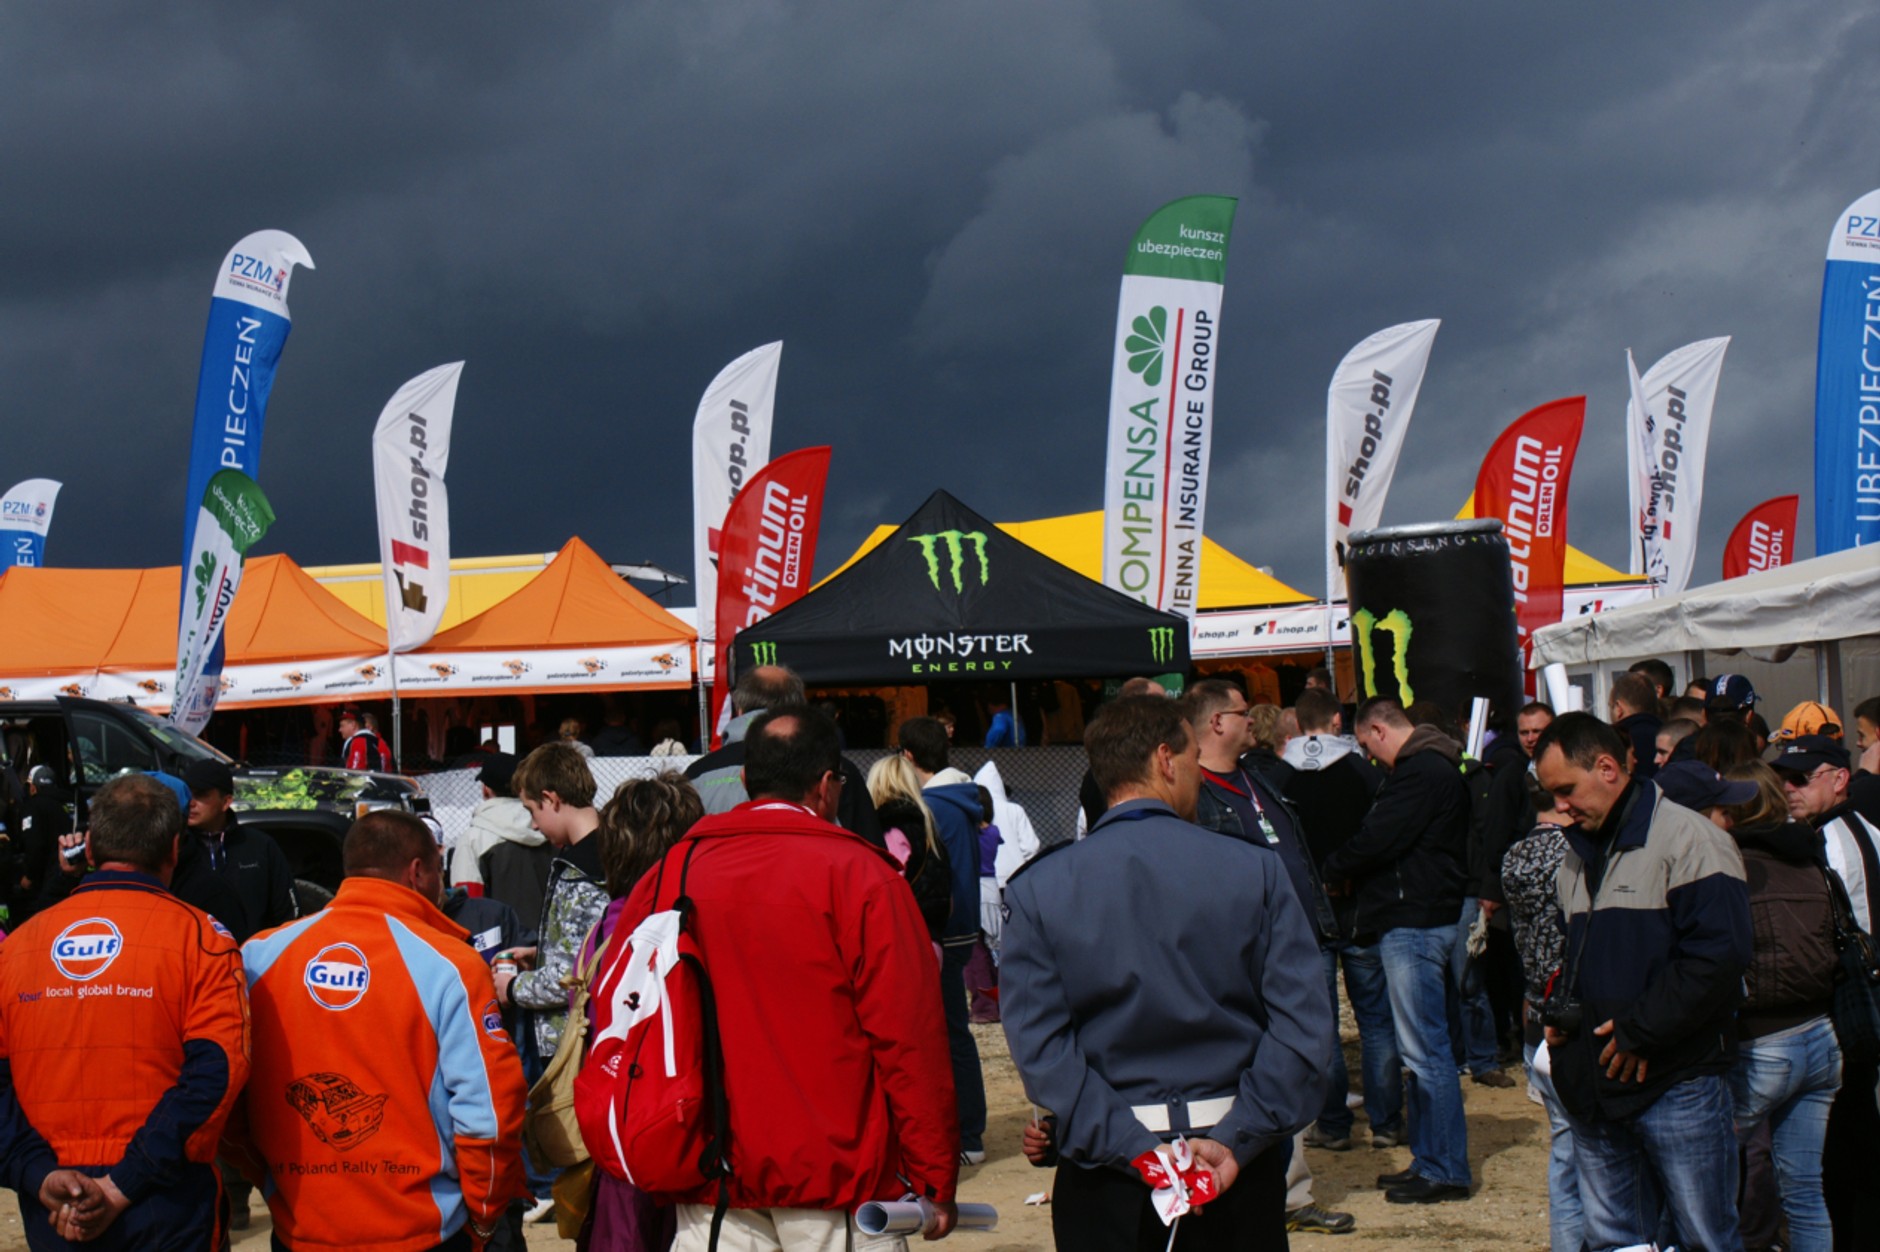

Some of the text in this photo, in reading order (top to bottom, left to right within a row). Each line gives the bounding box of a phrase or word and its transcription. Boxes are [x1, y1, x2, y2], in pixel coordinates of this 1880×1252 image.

[1179, 224, 1225, 244] kunszt
[1848, 216, 1880, 237] PZ
[1137, 240, 1223, 262] ubezpieczeń
[231, 253, 273, 283] PZM
[1184, 309, 1213, 391] GROUP
[221, 316, 262, 469] PIECZEŃ
[1174, 400, 1204, 529] INSURANCE
[1119, 397, 1160, 604] OMPENSA
[1538, 445, 1563, 535] ORLEN OIL
[14, 537, 34, 567] EŃ
[785, 495, 808, 586] ORLEN OIL
[1770, 528, 1784, 555] OIL
[888, 631, 1033, 659] MONSTER
[912, 660, 1012, 673] ENERGY
[57, 938, 118, 957] Gulf
[309, 965, 366, 988] Gulf
[18, 984, 153, 1003] Your local global brand
[289, 1162, 338, 1175] Poland
[343, 1161, 378, 1175] Rally
[382, 1159, 421, 1176] Team
